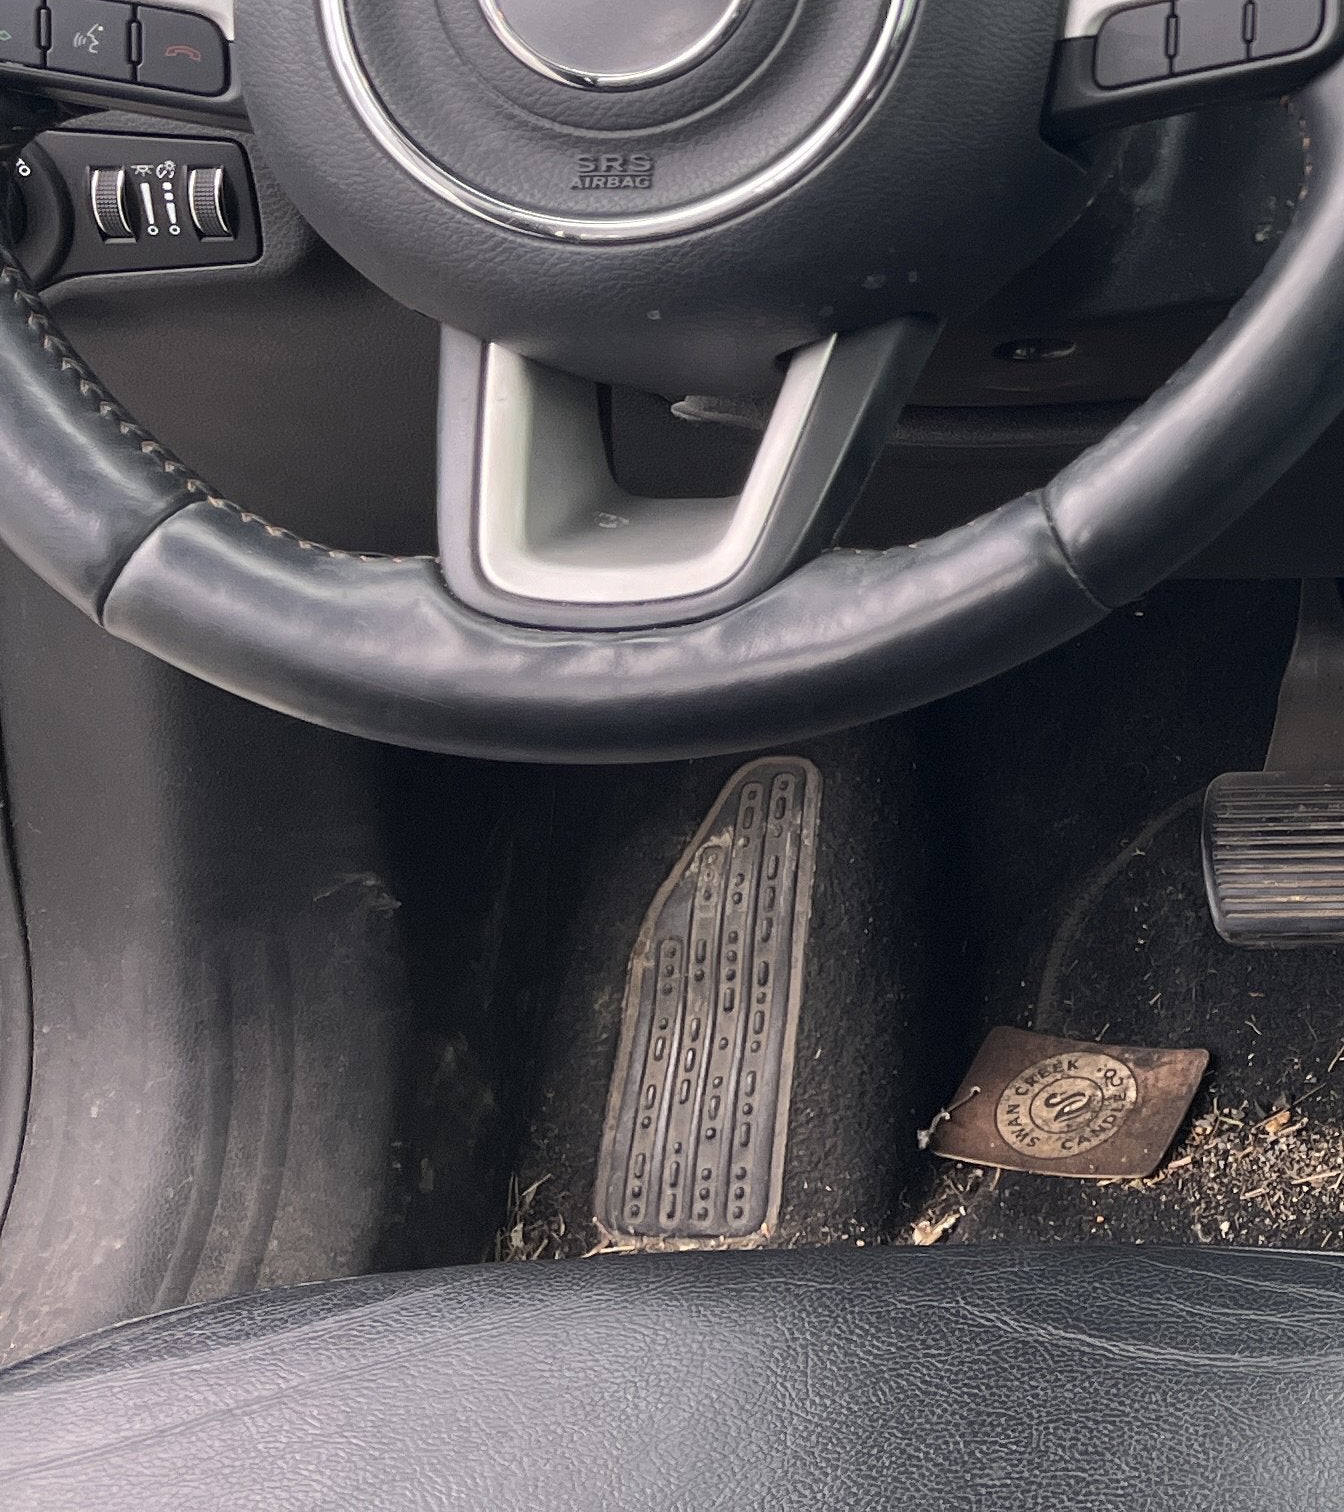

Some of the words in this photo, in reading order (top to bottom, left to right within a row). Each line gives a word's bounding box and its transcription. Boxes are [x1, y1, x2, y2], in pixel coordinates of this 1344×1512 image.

[575, 154, 654, 173] SRS
[570, 175, 652, 190] AIRBAG
[1015, 1059, 1080, 1097] CREEK
[1006, 1103, 1041, 1148] SWAN
